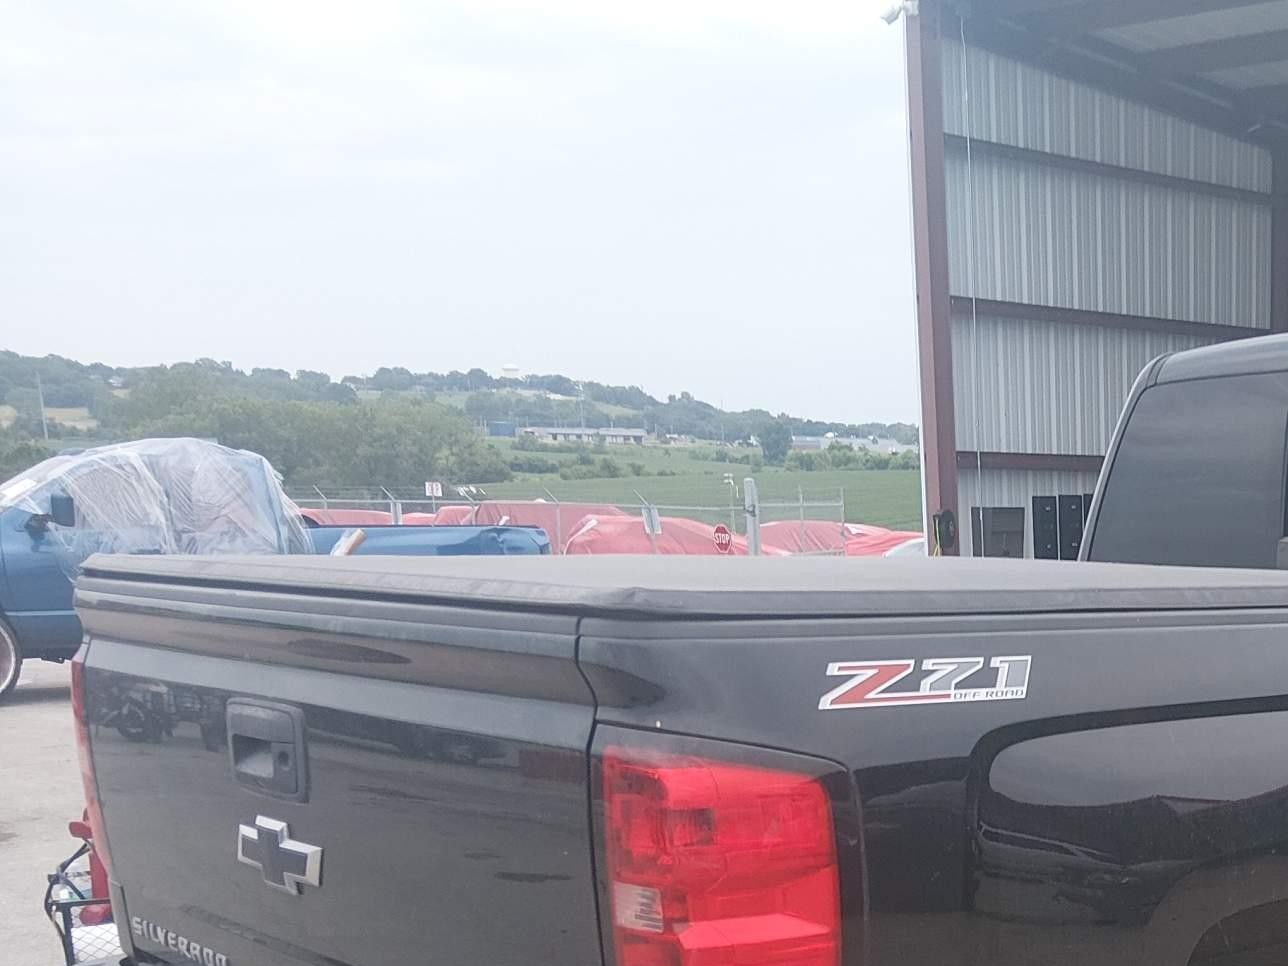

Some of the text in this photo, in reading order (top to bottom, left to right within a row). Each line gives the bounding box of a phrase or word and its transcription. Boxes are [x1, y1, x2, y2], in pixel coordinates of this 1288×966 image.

[714, 532, 730, 545] STOP
[818, 655, 1032, 710] Z71
[953, 688, 1025, 701] OFF ROAD
